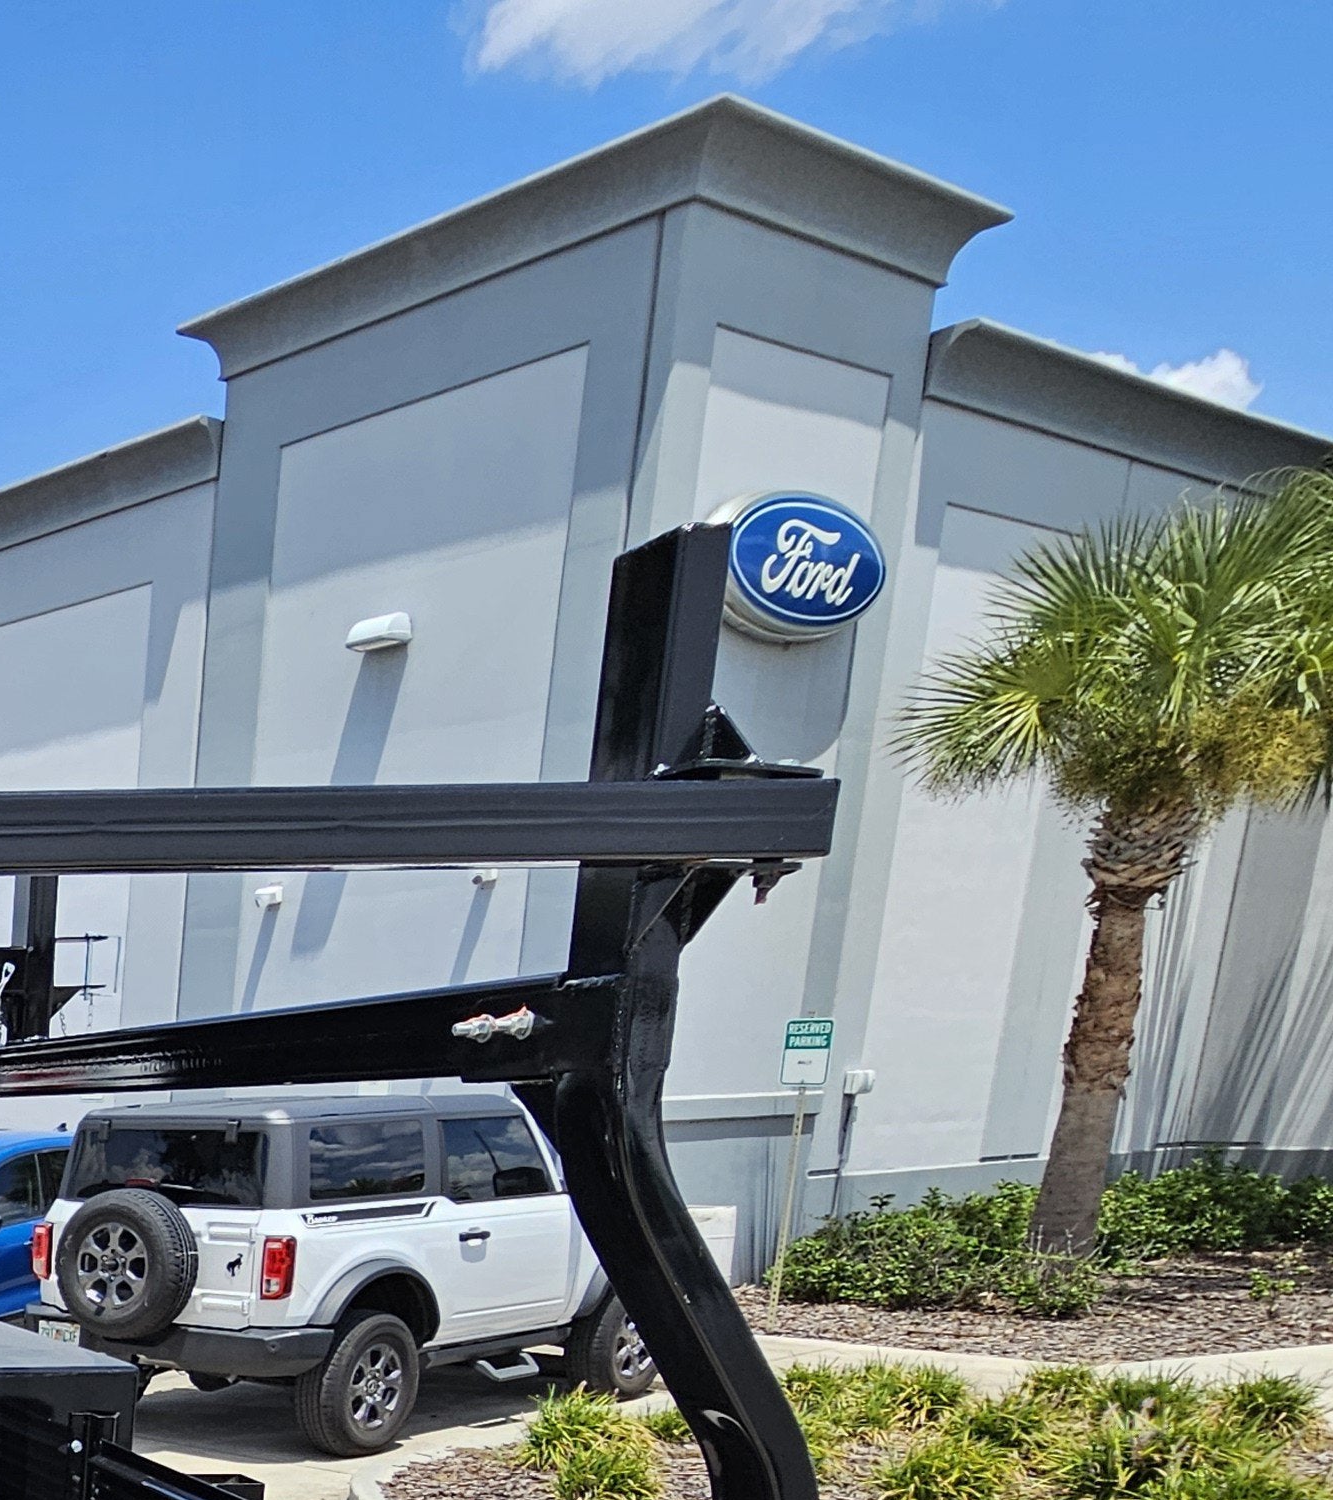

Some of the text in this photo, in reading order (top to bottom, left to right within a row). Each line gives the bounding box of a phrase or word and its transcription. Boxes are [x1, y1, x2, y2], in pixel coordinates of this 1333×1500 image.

[761, 518, 861, 607] Ford
[788, 1022, 831, 1034] RESERVED
[788, 1035, 828, 1047] PARKING
